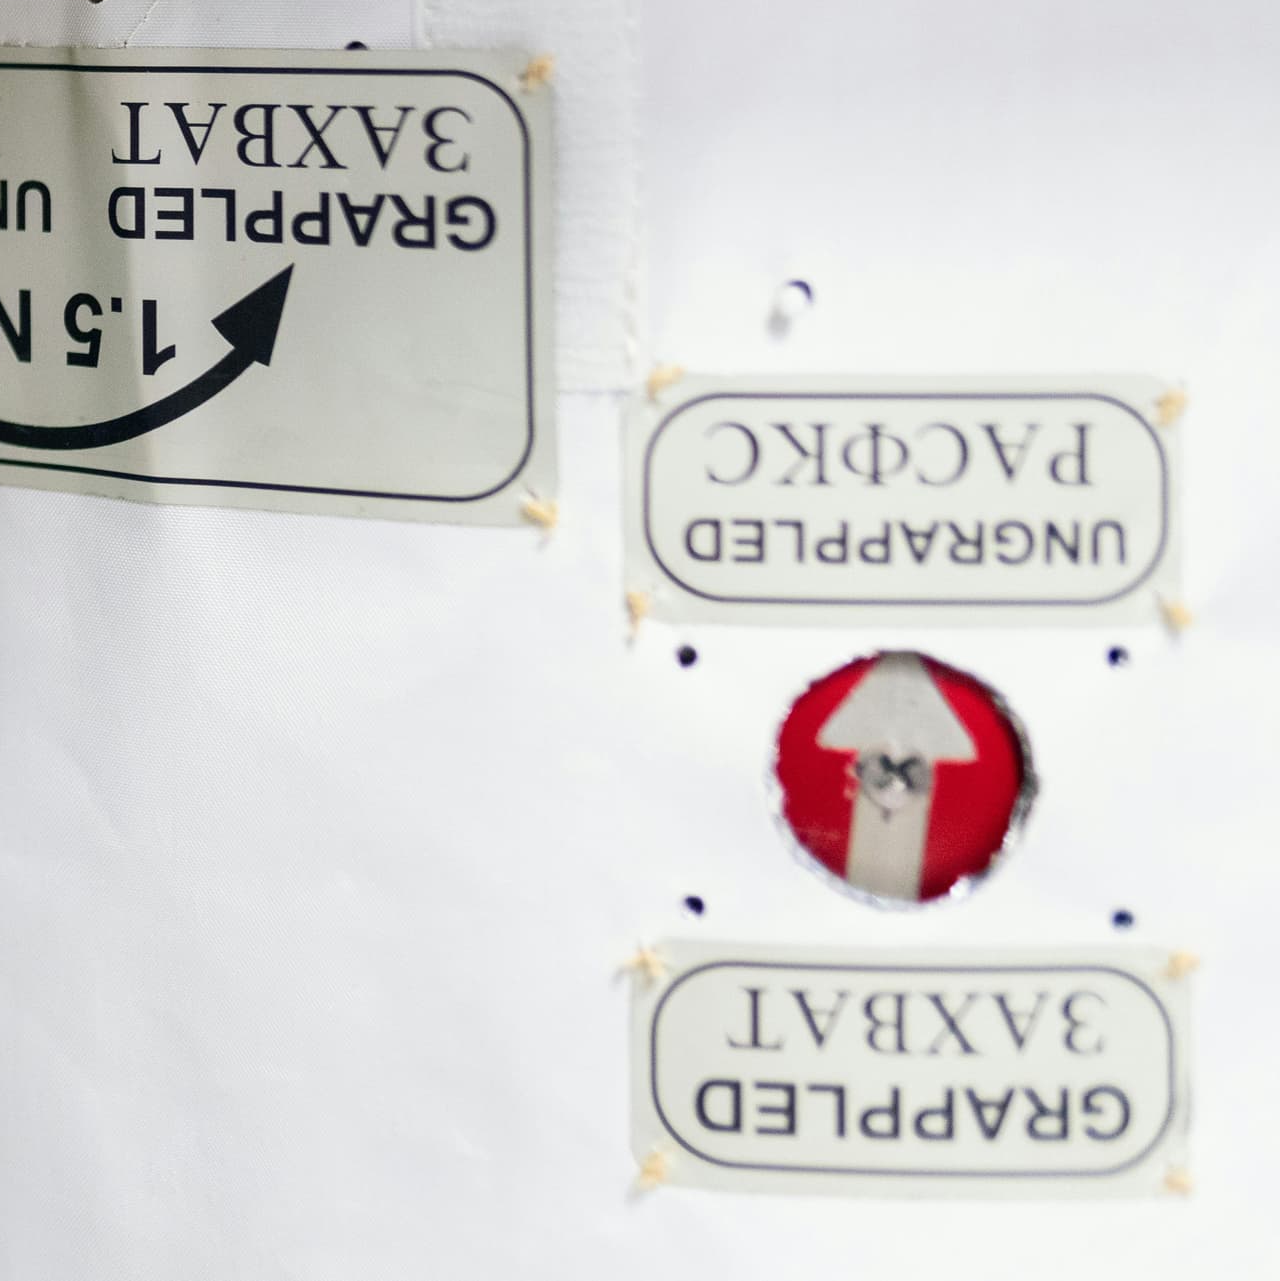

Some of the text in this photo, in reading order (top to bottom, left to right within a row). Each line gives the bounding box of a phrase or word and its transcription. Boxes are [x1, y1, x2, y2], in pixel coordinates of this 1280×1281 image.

[111, 101, 473, 174] ЗАХВАТ
[107, 185, 498, 253] GRAPPLED
[64, 292, 177, 376] 1.5
[704, 420, 1095, 488] РАСФКС
[683, 517, 1127, 567] UNGRAPPLED
[724, 985, 1110, 1057] ЗАХВАТ
[694, 1078, 1132, 1142] GRAPPLED
